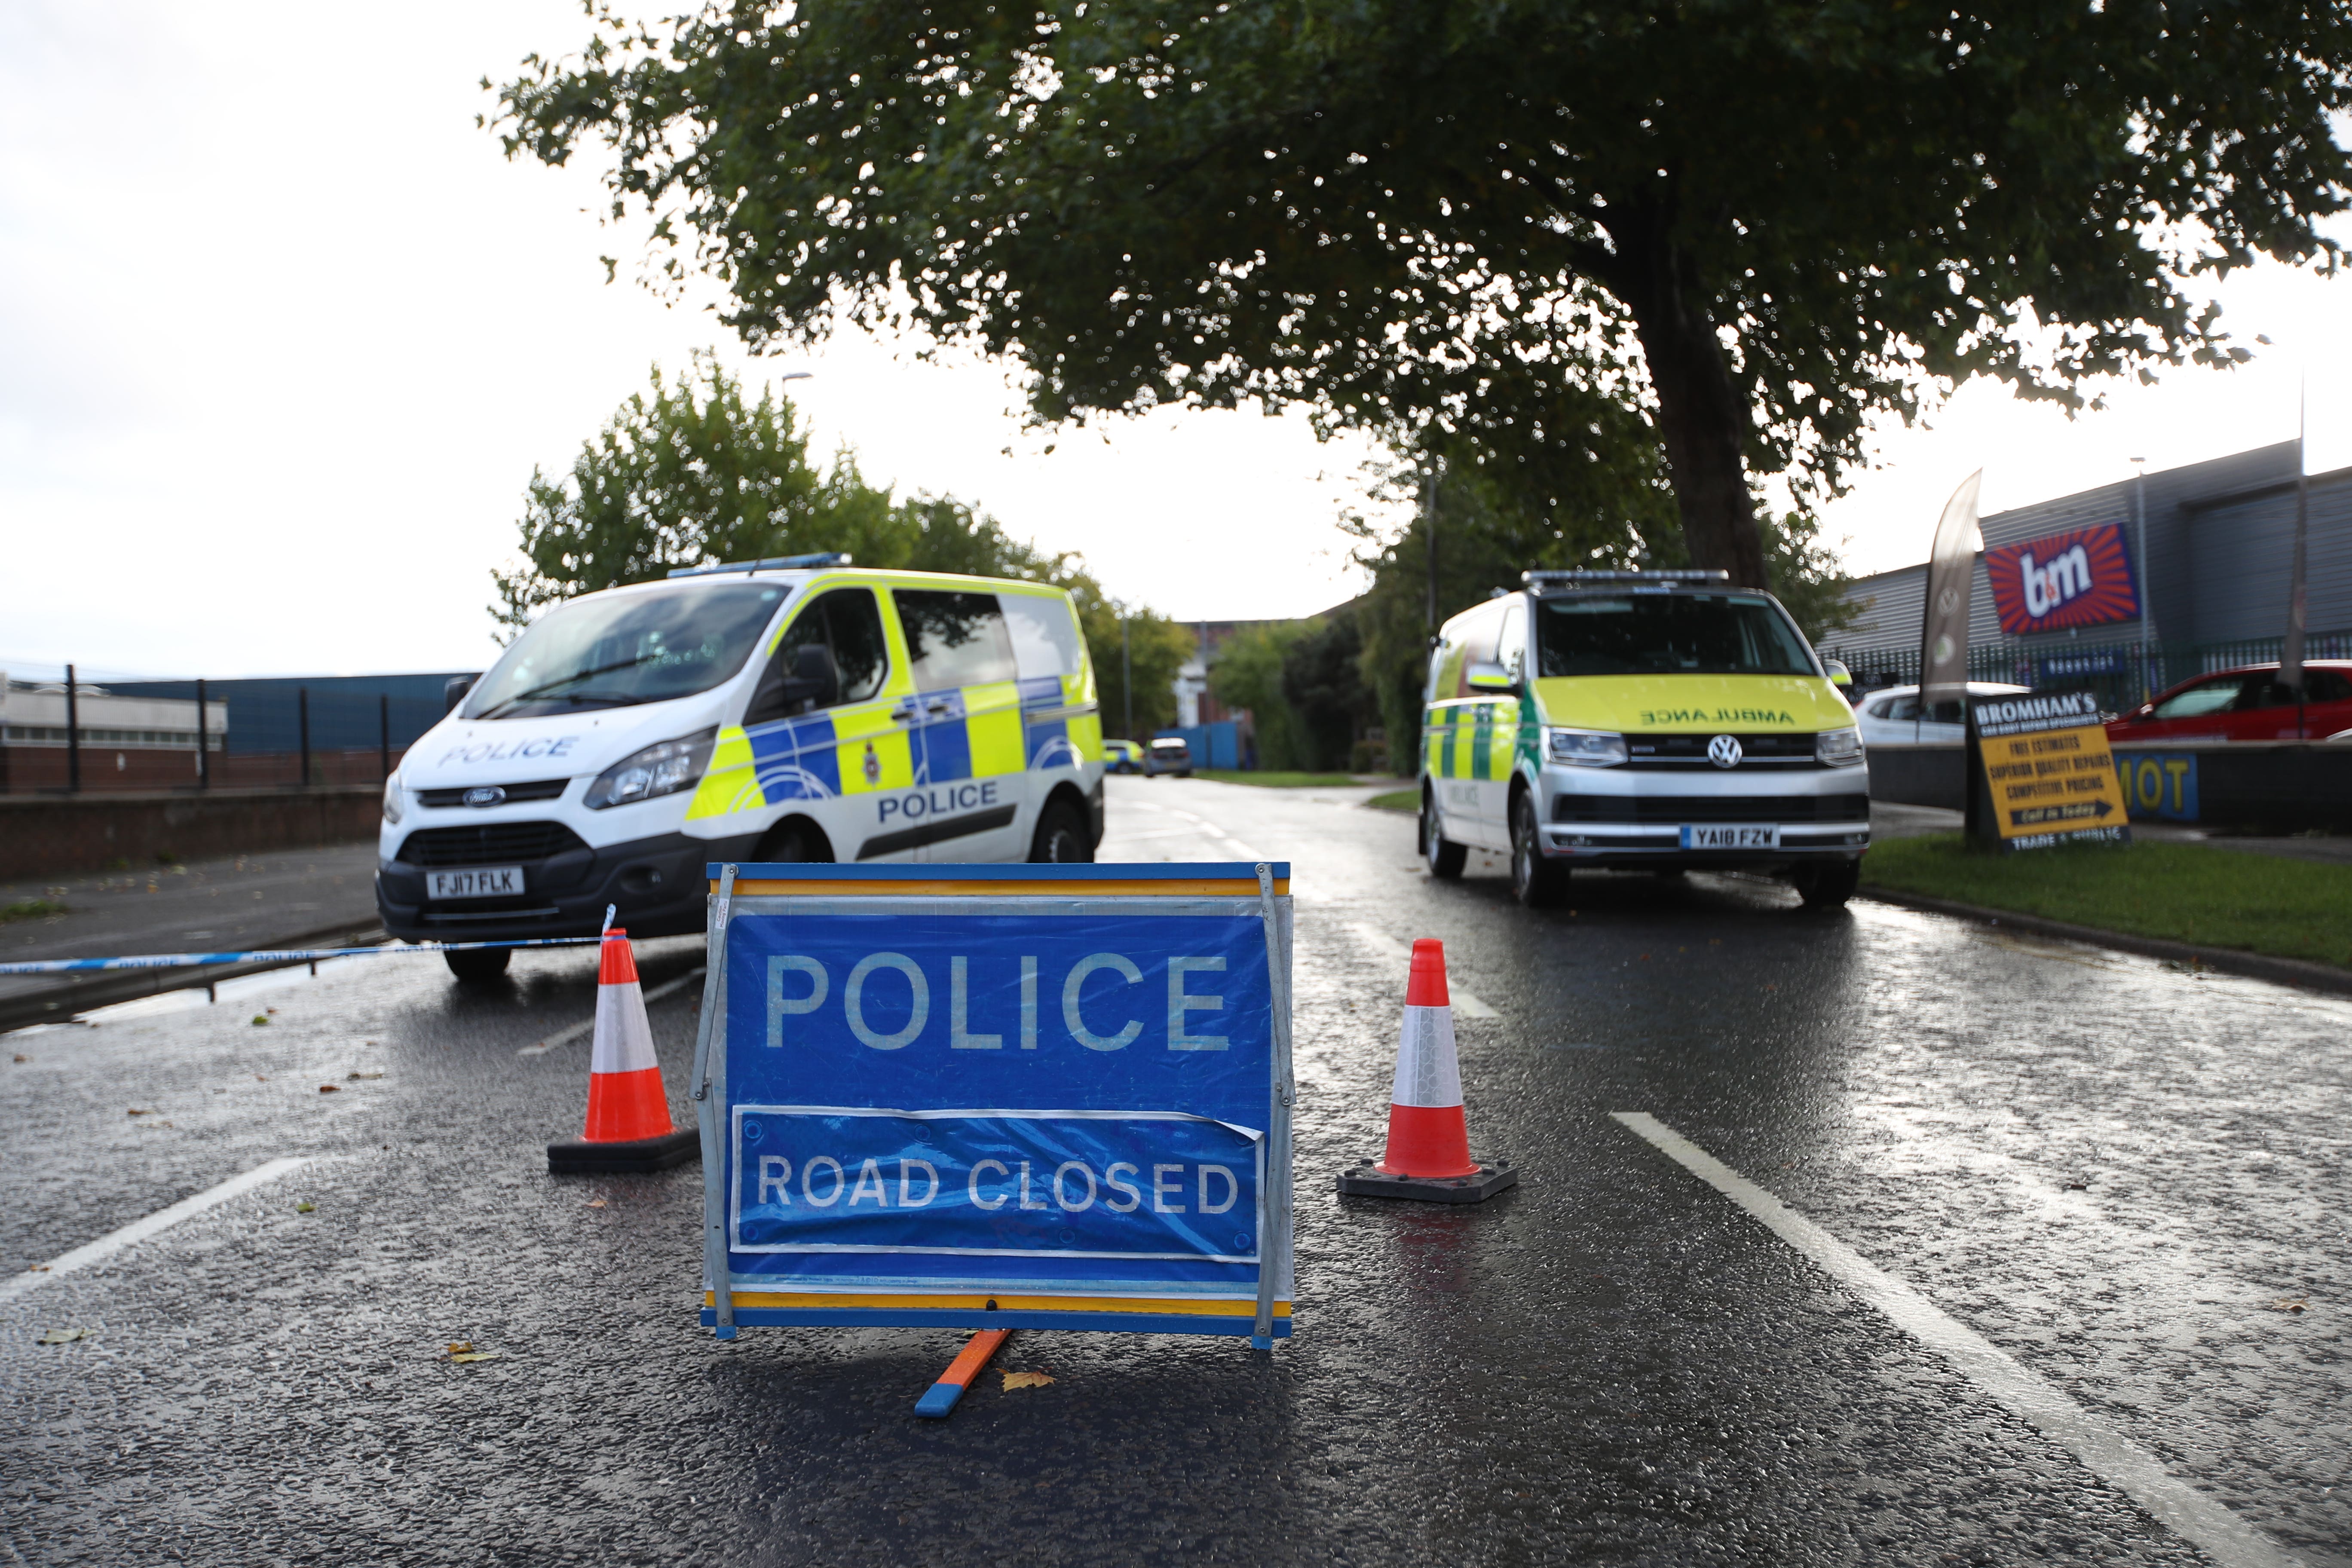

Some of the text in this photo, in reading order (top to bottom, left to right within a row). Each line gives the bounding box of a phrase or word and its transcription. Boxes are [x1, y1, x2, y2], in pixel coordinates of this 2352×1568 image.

[1975, 692, 2097, 726] BROMHAM'S
[437, 736, 580, 769] POLICE
[2073, 753, 2110, 769] REPAIRS
[2065, 776, 2104, 793] PRICING
[878, 781, 997, 824] POLICE
[1697, 828, 1773, 845] YA18 FZW
[2012, 833, 2055, 851] TRADE
[437, 870, 513, 895] FJ17 FLK
[766, 952, 1229, 1051] POLICE
[758, 1155, 1238, 1215] ROAD CLOSED
